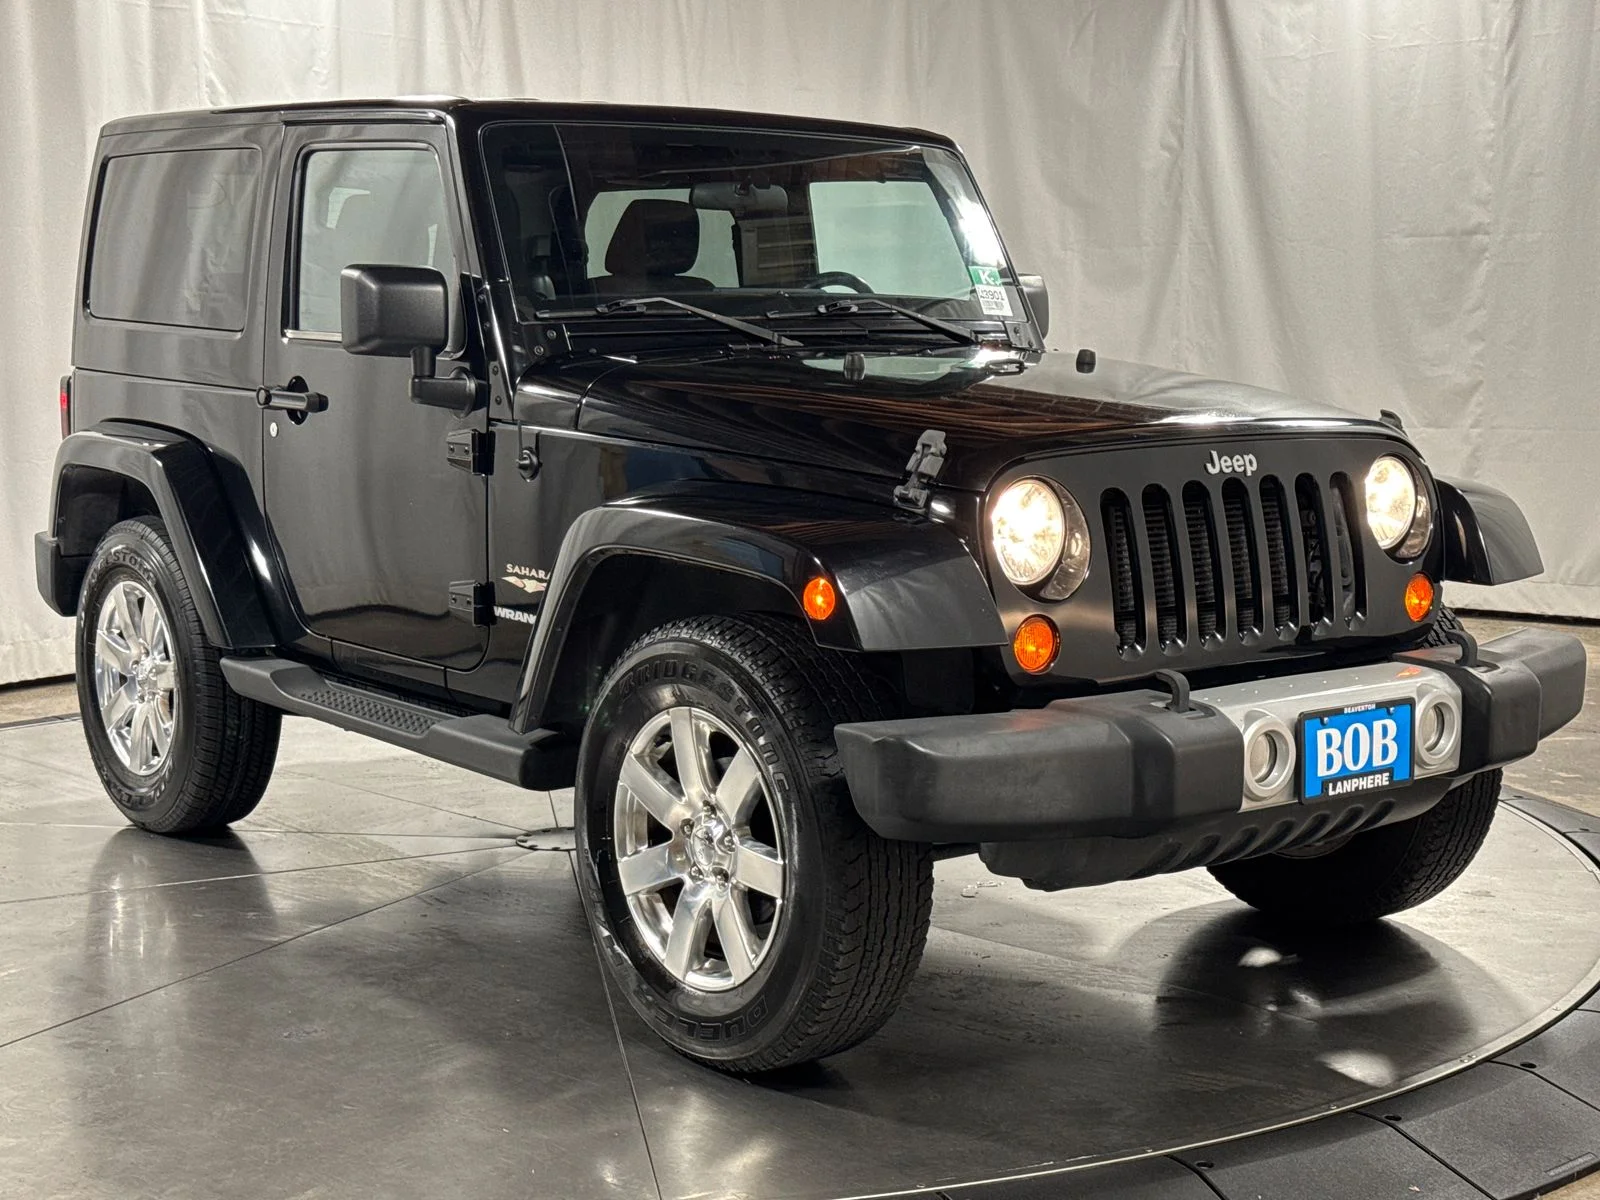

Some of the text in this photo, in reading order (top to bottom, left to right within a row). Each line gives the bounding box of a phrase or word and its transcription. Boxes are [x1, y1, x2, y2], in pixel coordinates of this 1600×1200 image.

[1205, 450, 1258, 477] Jeep
[1344, 703, 1376, 714] BEAVERTON
[1316, 718, 1398, 777] BOB
[1328, 772, 1390, 796] LANPHERE
